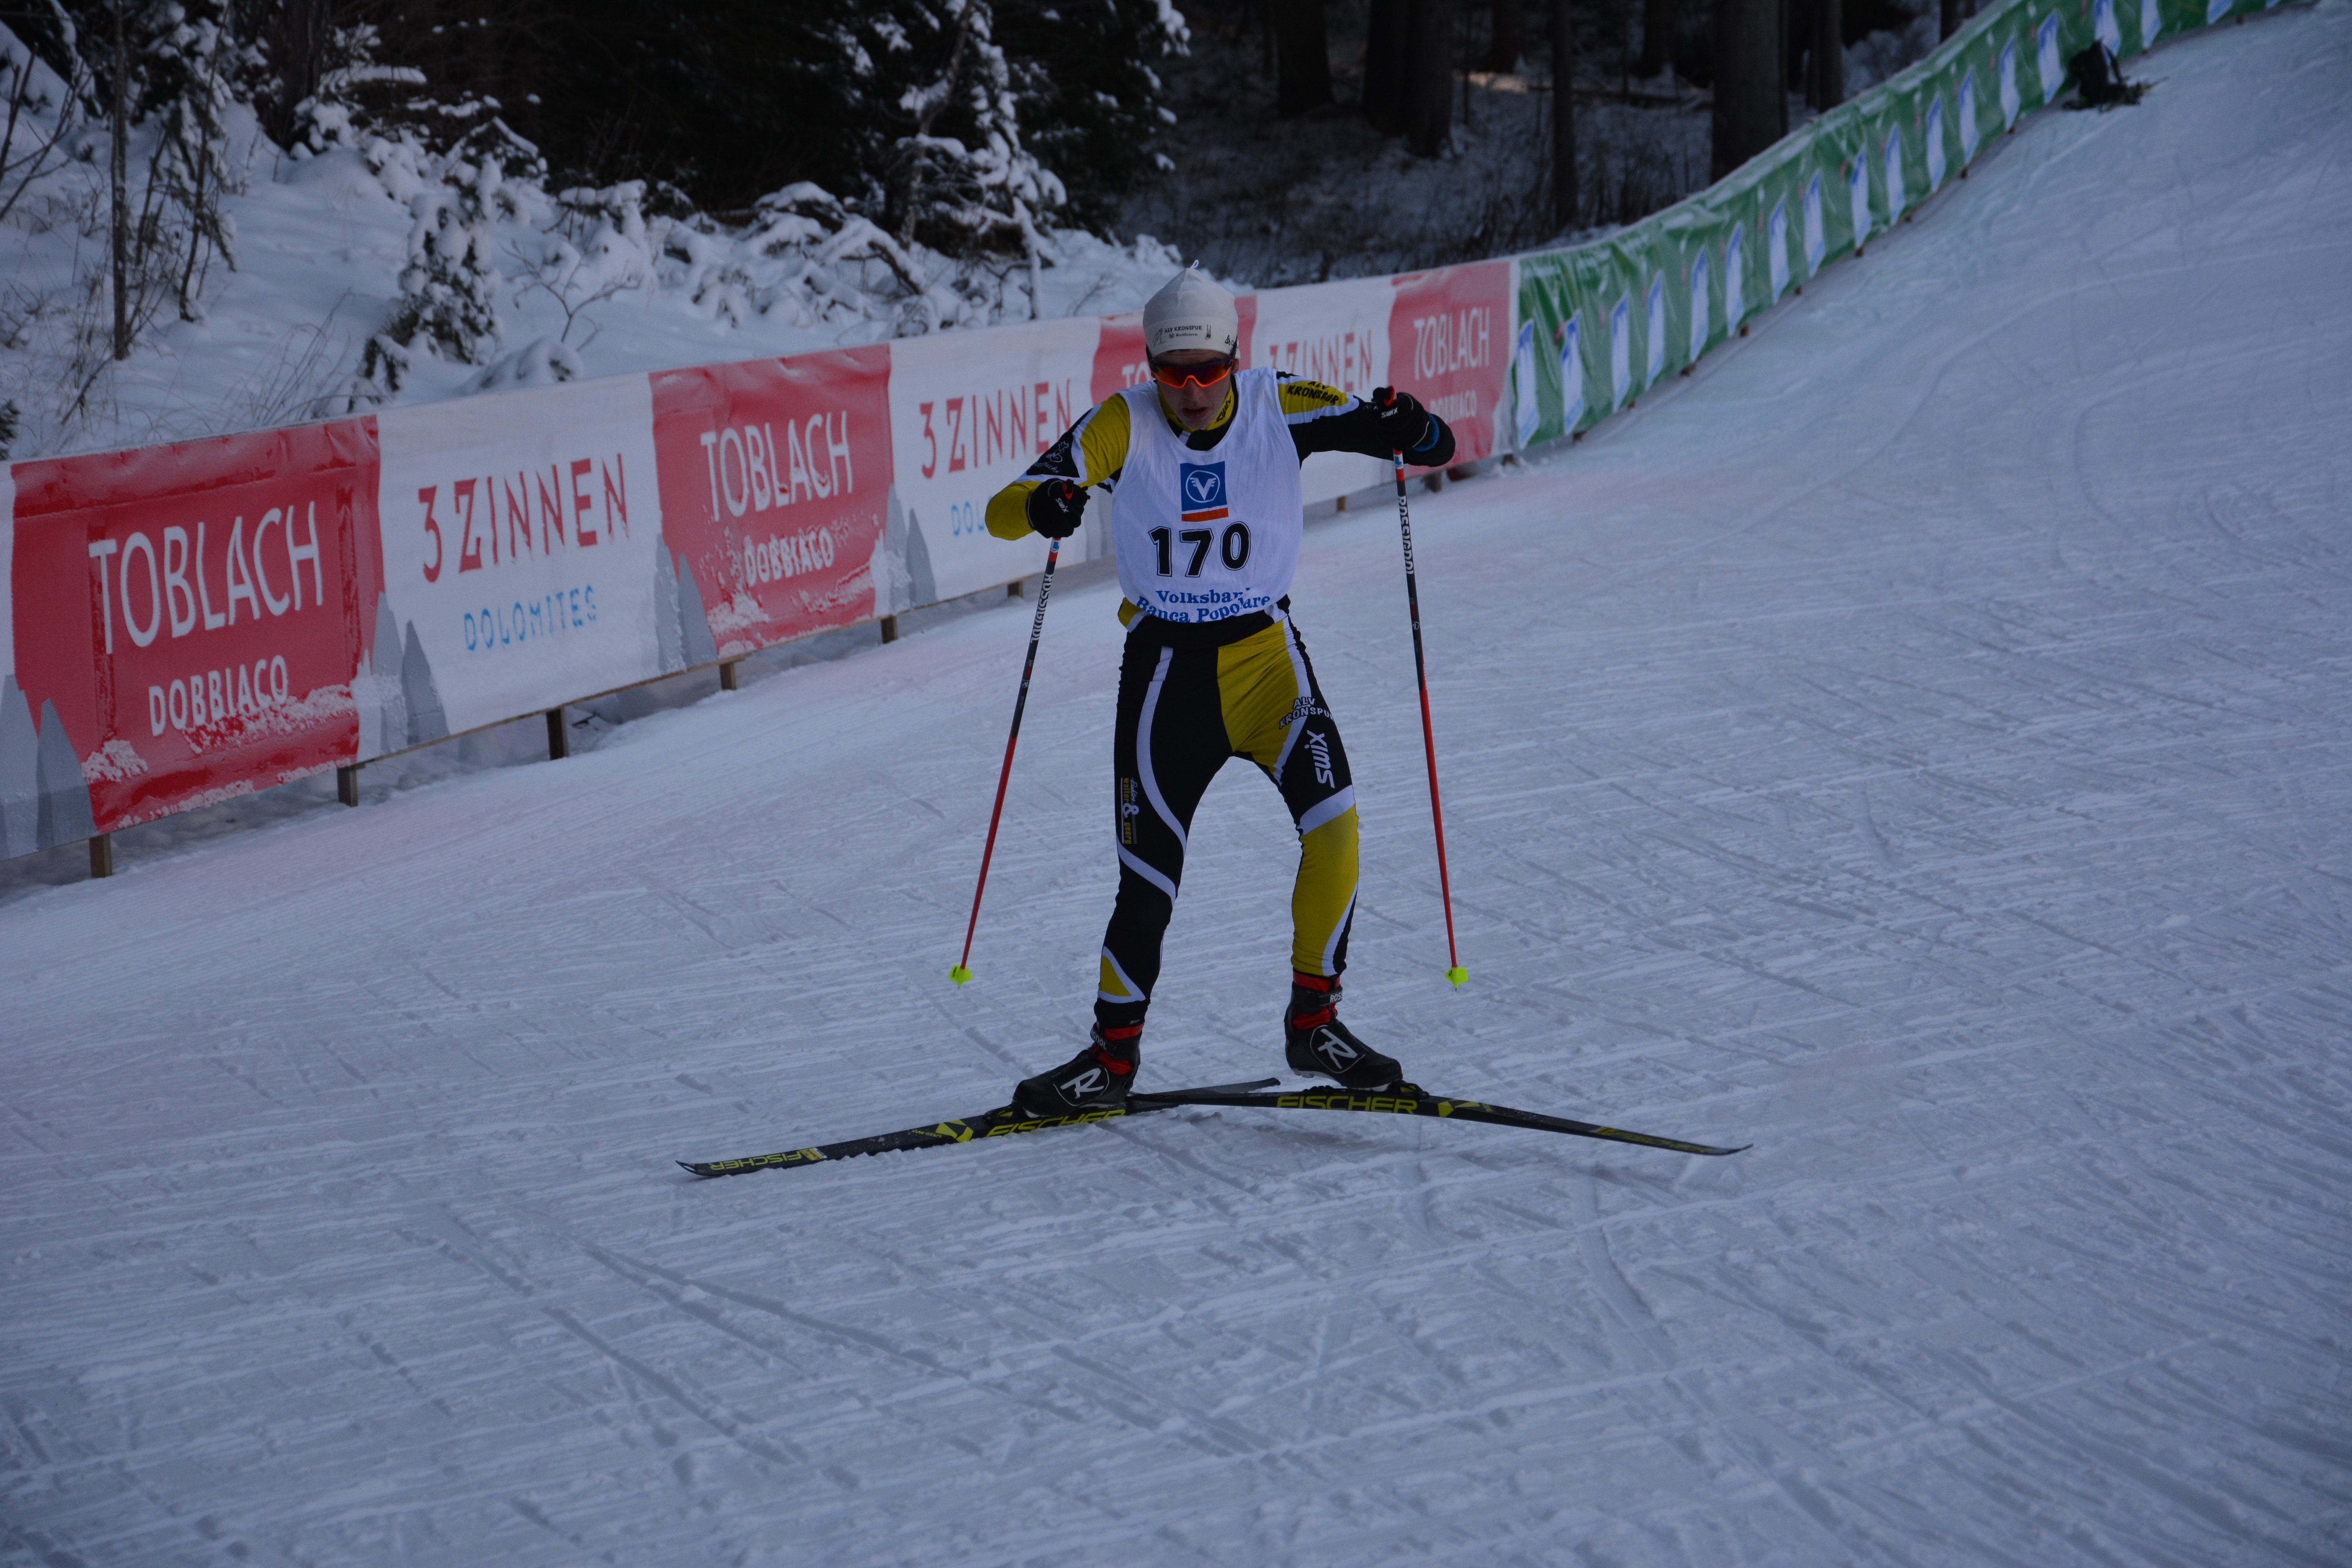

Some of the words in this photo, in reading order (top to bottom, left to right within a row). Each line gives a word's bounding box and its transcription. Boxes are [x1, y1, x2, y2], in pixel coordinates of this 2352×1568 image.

[1414, 306, 1490, 381] TOBLACH
[1287, 385, 1339, 404] KRONSPUR
[1307, 381, 1329, 389] ALV
[701, 410, 853, 522] TOBLACH
[1148, 521, 1251, 578] 170
[88, 500, 324, 654] TOBLACH
[464, 585, 597, 651] DOLOMITES
[1136, 596, 1191, 623] Banca
[1196, 596, 1270, 622] Popolare
[148, 655, 289, 737] DOBBIACO
[1293, 697, 1316, 709] ALV
[1276, 1095, 1418, 1114] FISCHER
[708, 1151, 802, 1171] FISCHER
